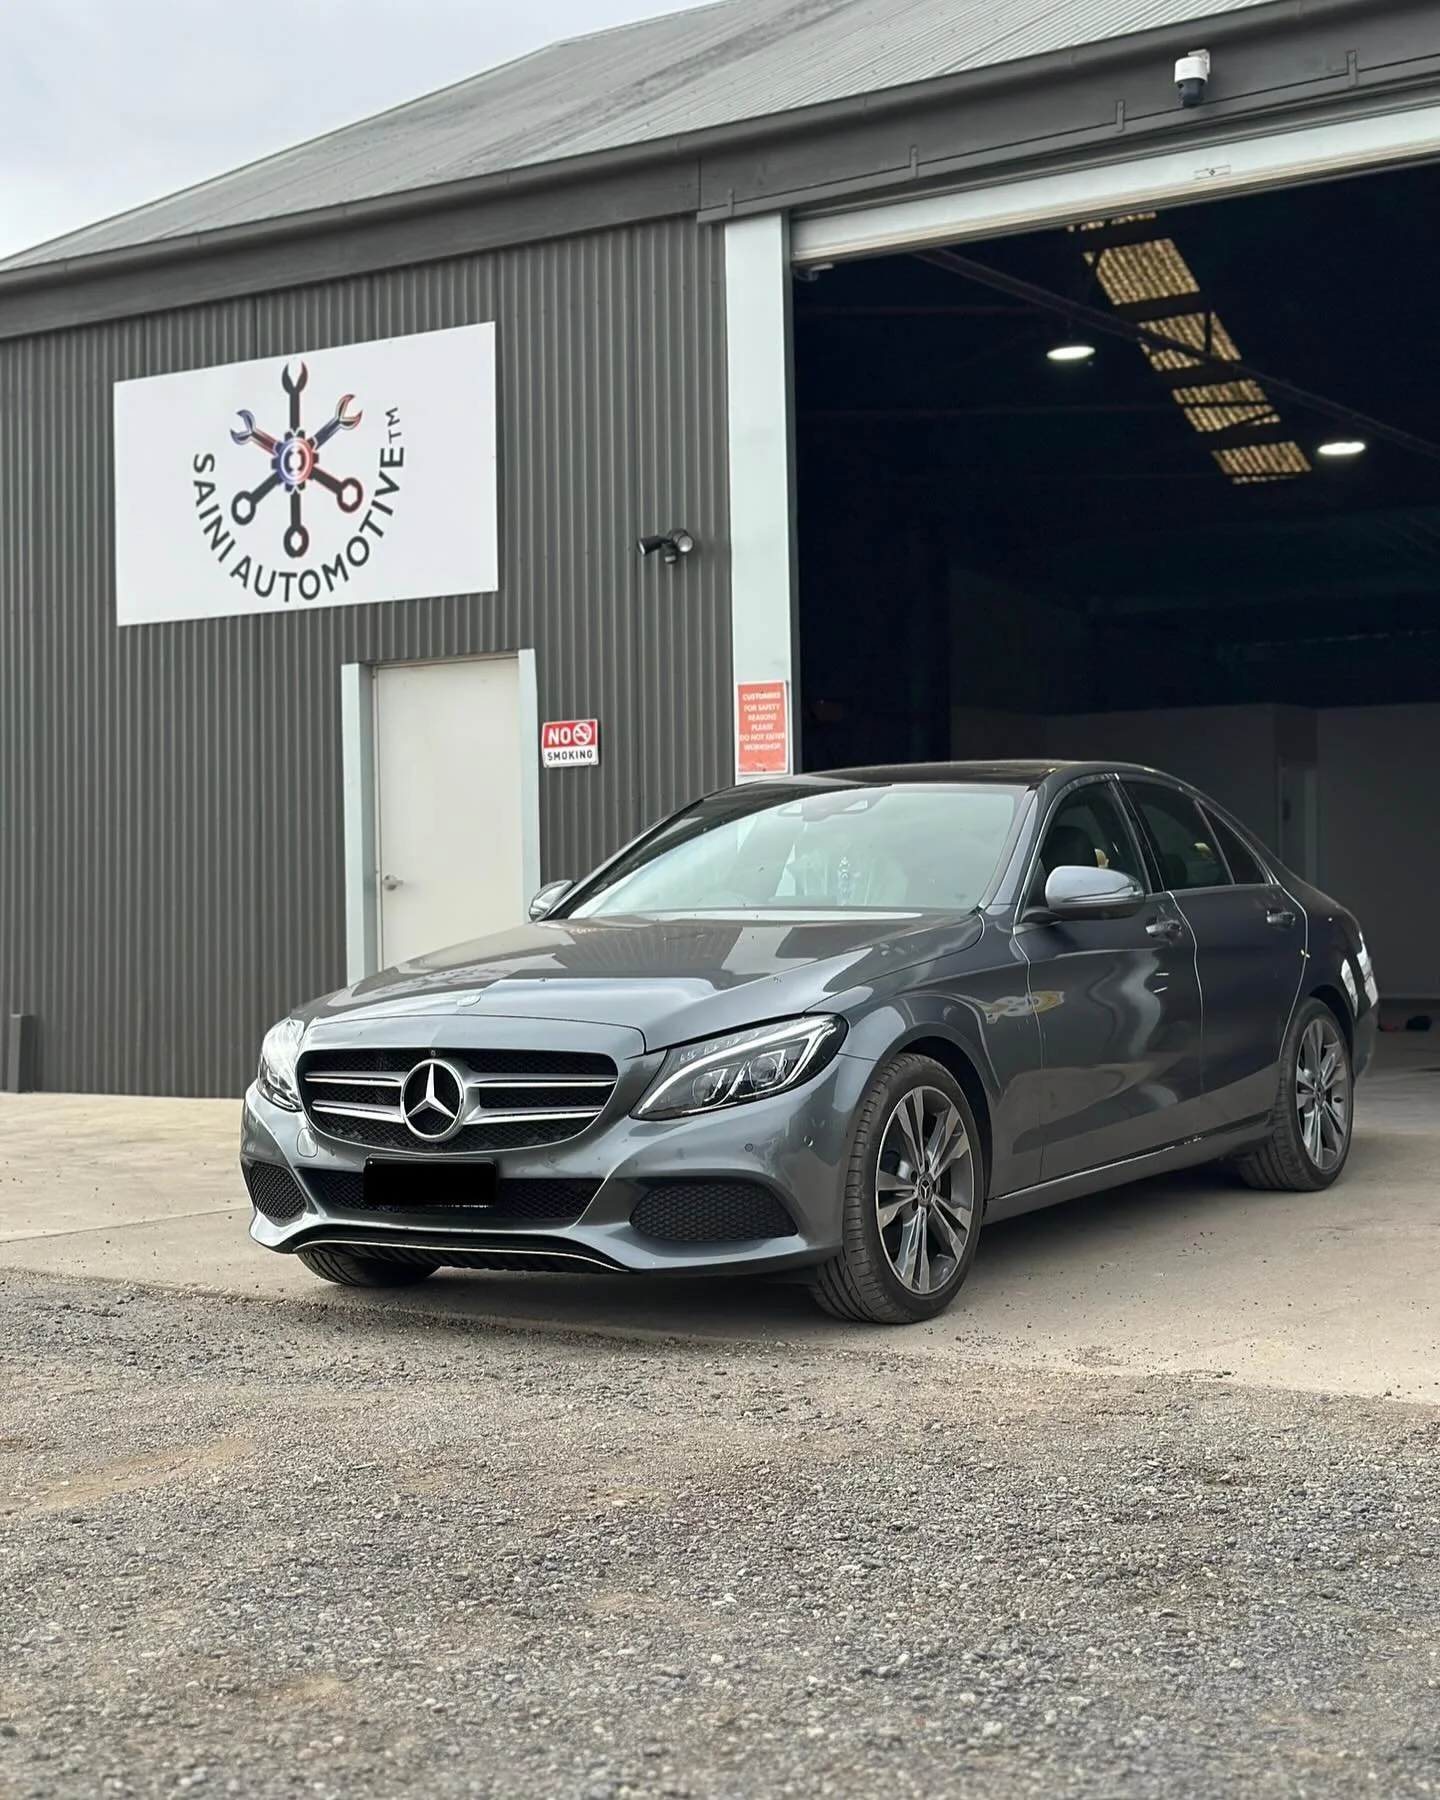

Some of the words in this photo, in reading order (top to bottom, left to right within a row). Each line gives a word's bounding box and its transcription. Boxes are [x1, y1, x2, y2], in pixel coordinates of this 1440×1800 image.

[192, 453, 236, 563] SAINI
[744, 704, 757, 712] FOR
[758, 703, 780, 711] SAFETY
[747, 713, 777, 721] REASONS
[751, 723, 774, 731] PLEASE
[548, 727, 571, 745] NO
[740, 733, 750, 742] DO
[751, 733, 765, 741] NOT
[766, 731, 785, 740] ENTER
[744, 743, 781, 751] WORKSHOP
[547, 749, 593, 761] SMOKING
